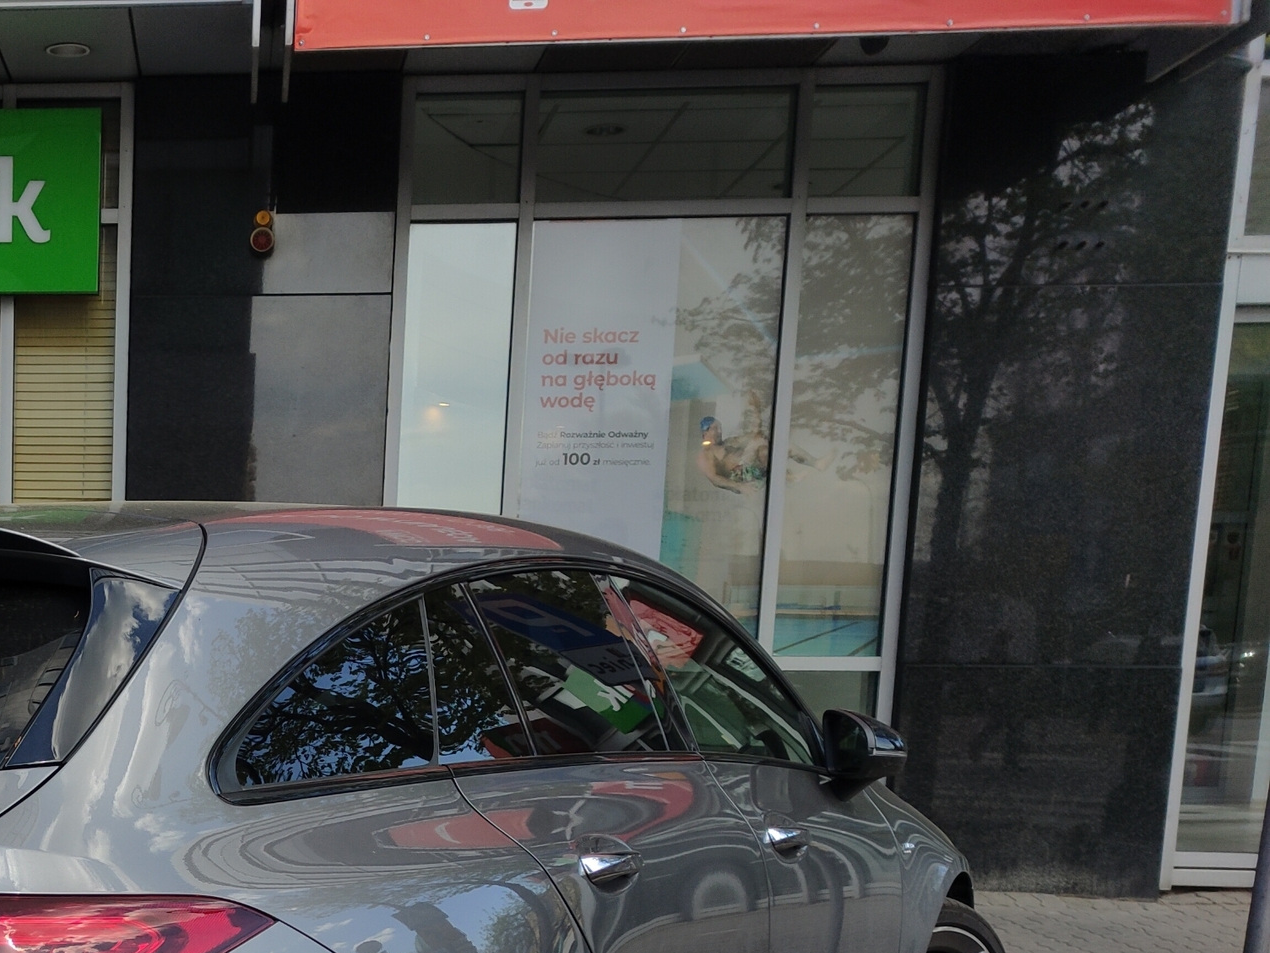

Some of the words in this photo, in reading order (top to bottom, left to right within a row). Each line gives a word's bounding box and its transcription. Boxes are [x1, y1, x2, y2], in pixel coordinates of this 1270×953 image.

[543, 327, 576, 344] Nie
[582, 328, 639, 343] skacz
[542, 350, 567, 365] od
[574, 352, 618, 365] razu
[541, 374, 567, 387] na
[573, 371, 656, 391] głęboką
[540, 393, 595, 412] wodę
[560, 430, 606, 439] Rozważnie
[608, 430, 649, 439] Odważny
[562, 452, 590, 466] 100
[593, 458, 601, 466] zł
